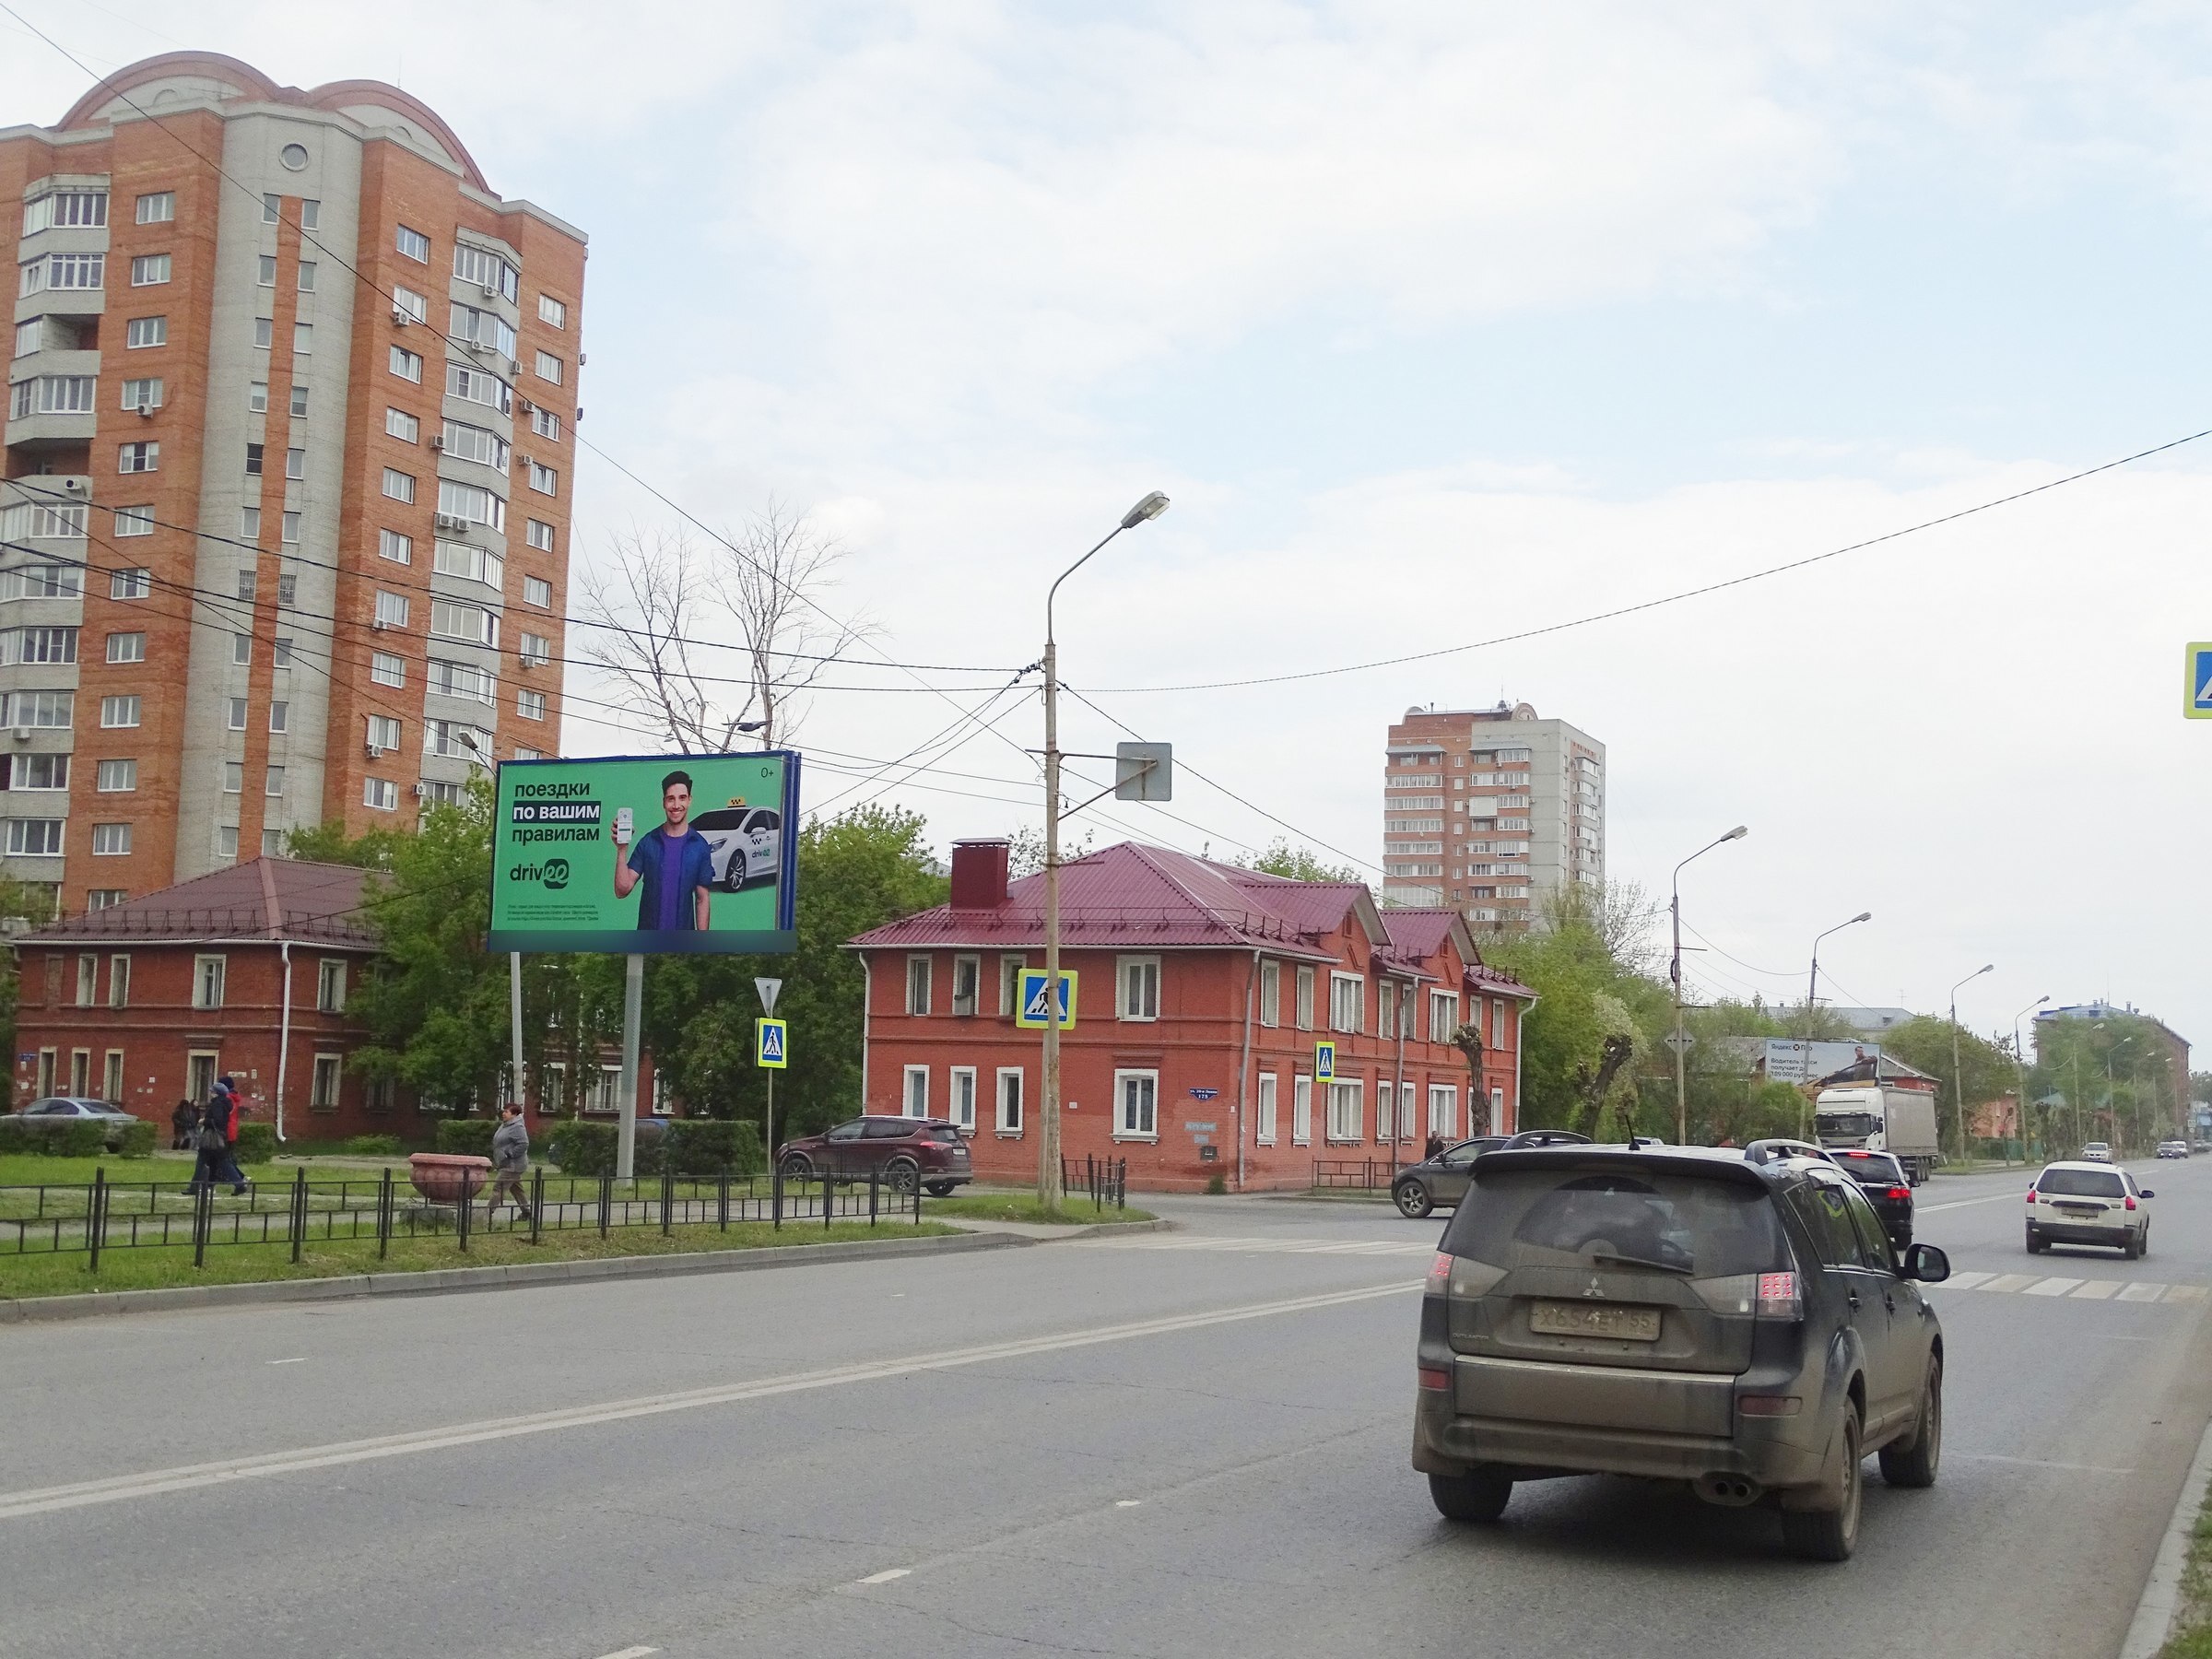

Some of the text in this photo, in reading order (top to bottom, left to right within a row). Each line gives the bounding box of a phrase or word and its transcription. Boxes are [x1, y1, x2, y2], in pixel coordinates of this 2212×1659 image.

[760, 767, 774, 778] 0+
[514, 782, 590, 798] поездки
[513, 803, 600, 820] по вашим
[512, 826, 600, 846] правилам
[510, 860, 570, 888] drivee
